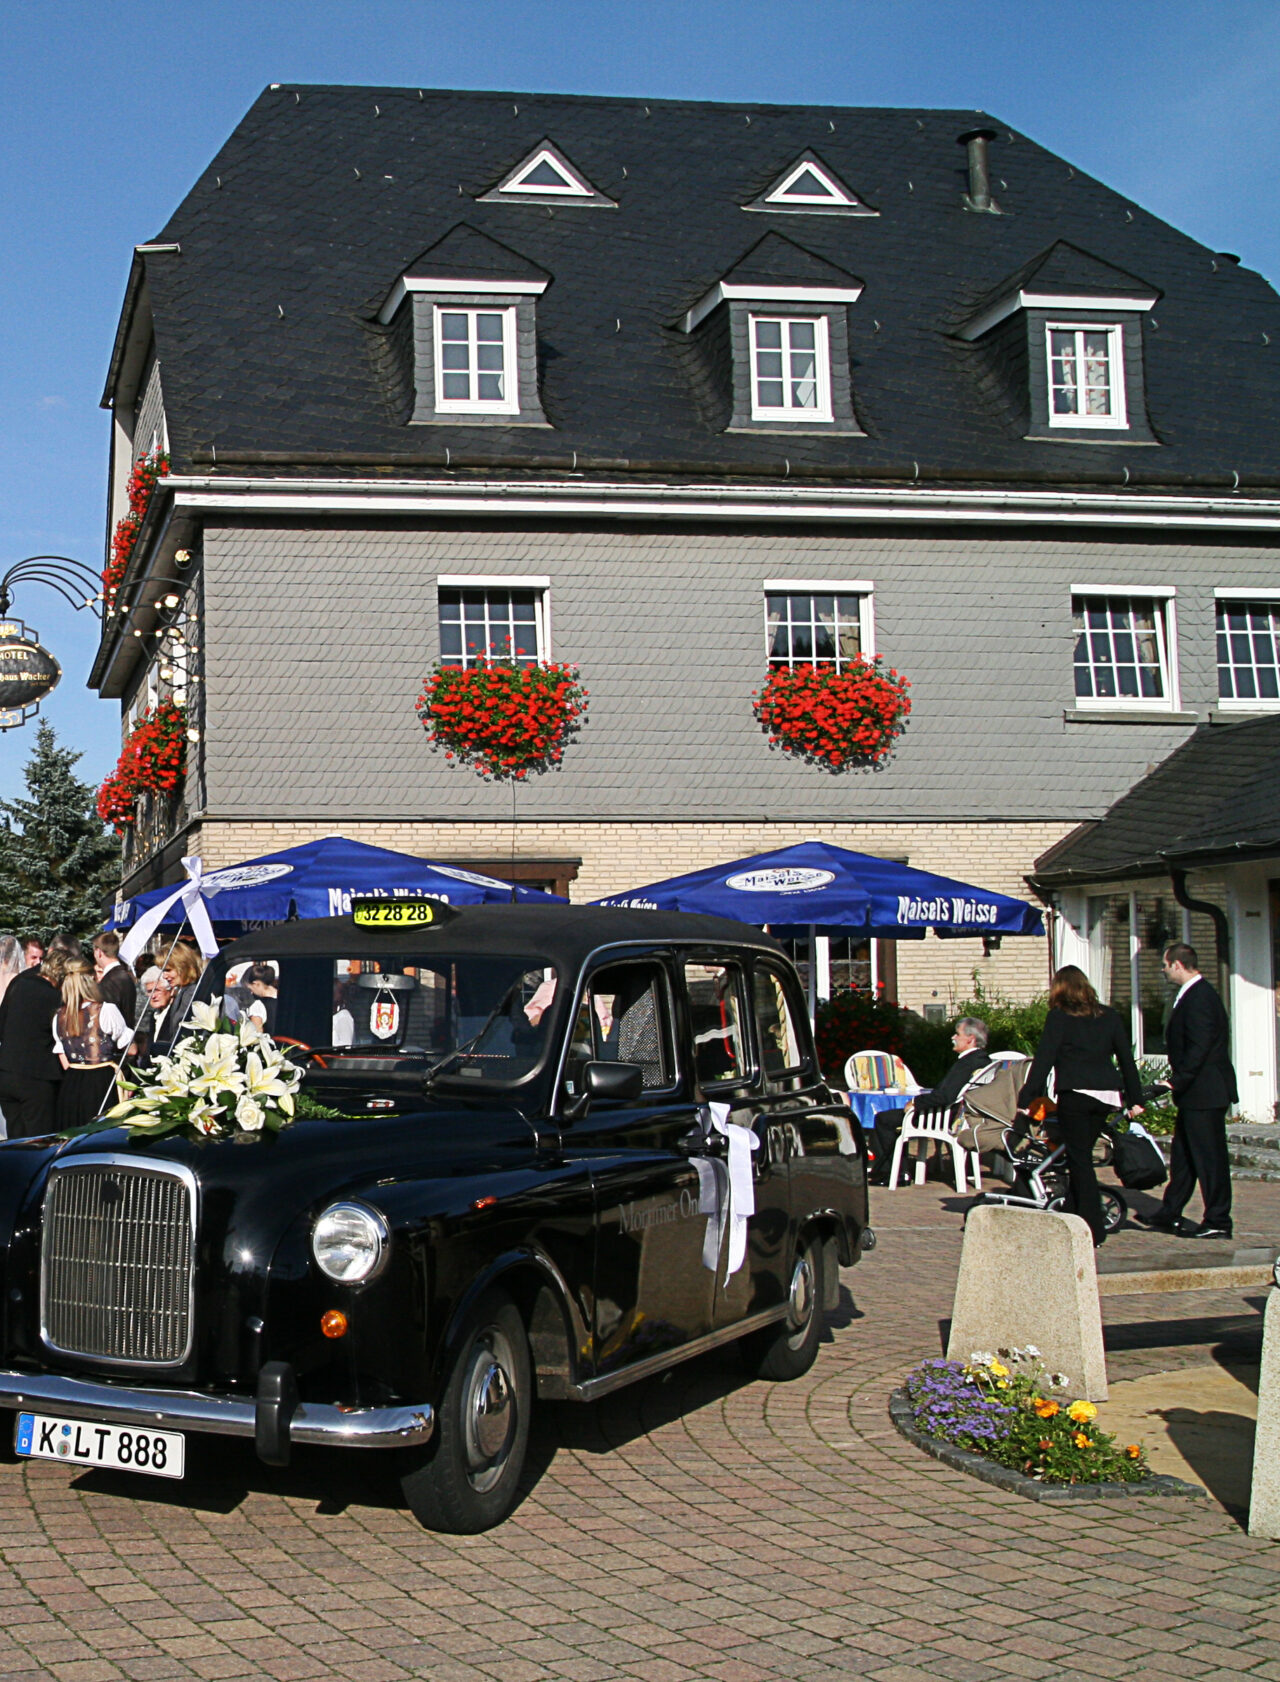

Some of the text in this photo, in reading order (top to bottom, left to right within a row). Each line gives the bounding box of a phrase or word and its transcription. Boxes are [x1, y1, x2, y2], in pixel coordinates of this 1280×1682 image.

[364, 904, 428, 921] 32 28 28
[897, 896, 998, 925] Maisel's Weisse
[680, 1189, 701, 1218] On
[21, 1438, 29, 1448] D
[74, 1426, 111, 1460] LT
[117, 1432, 167, 1469] 888
